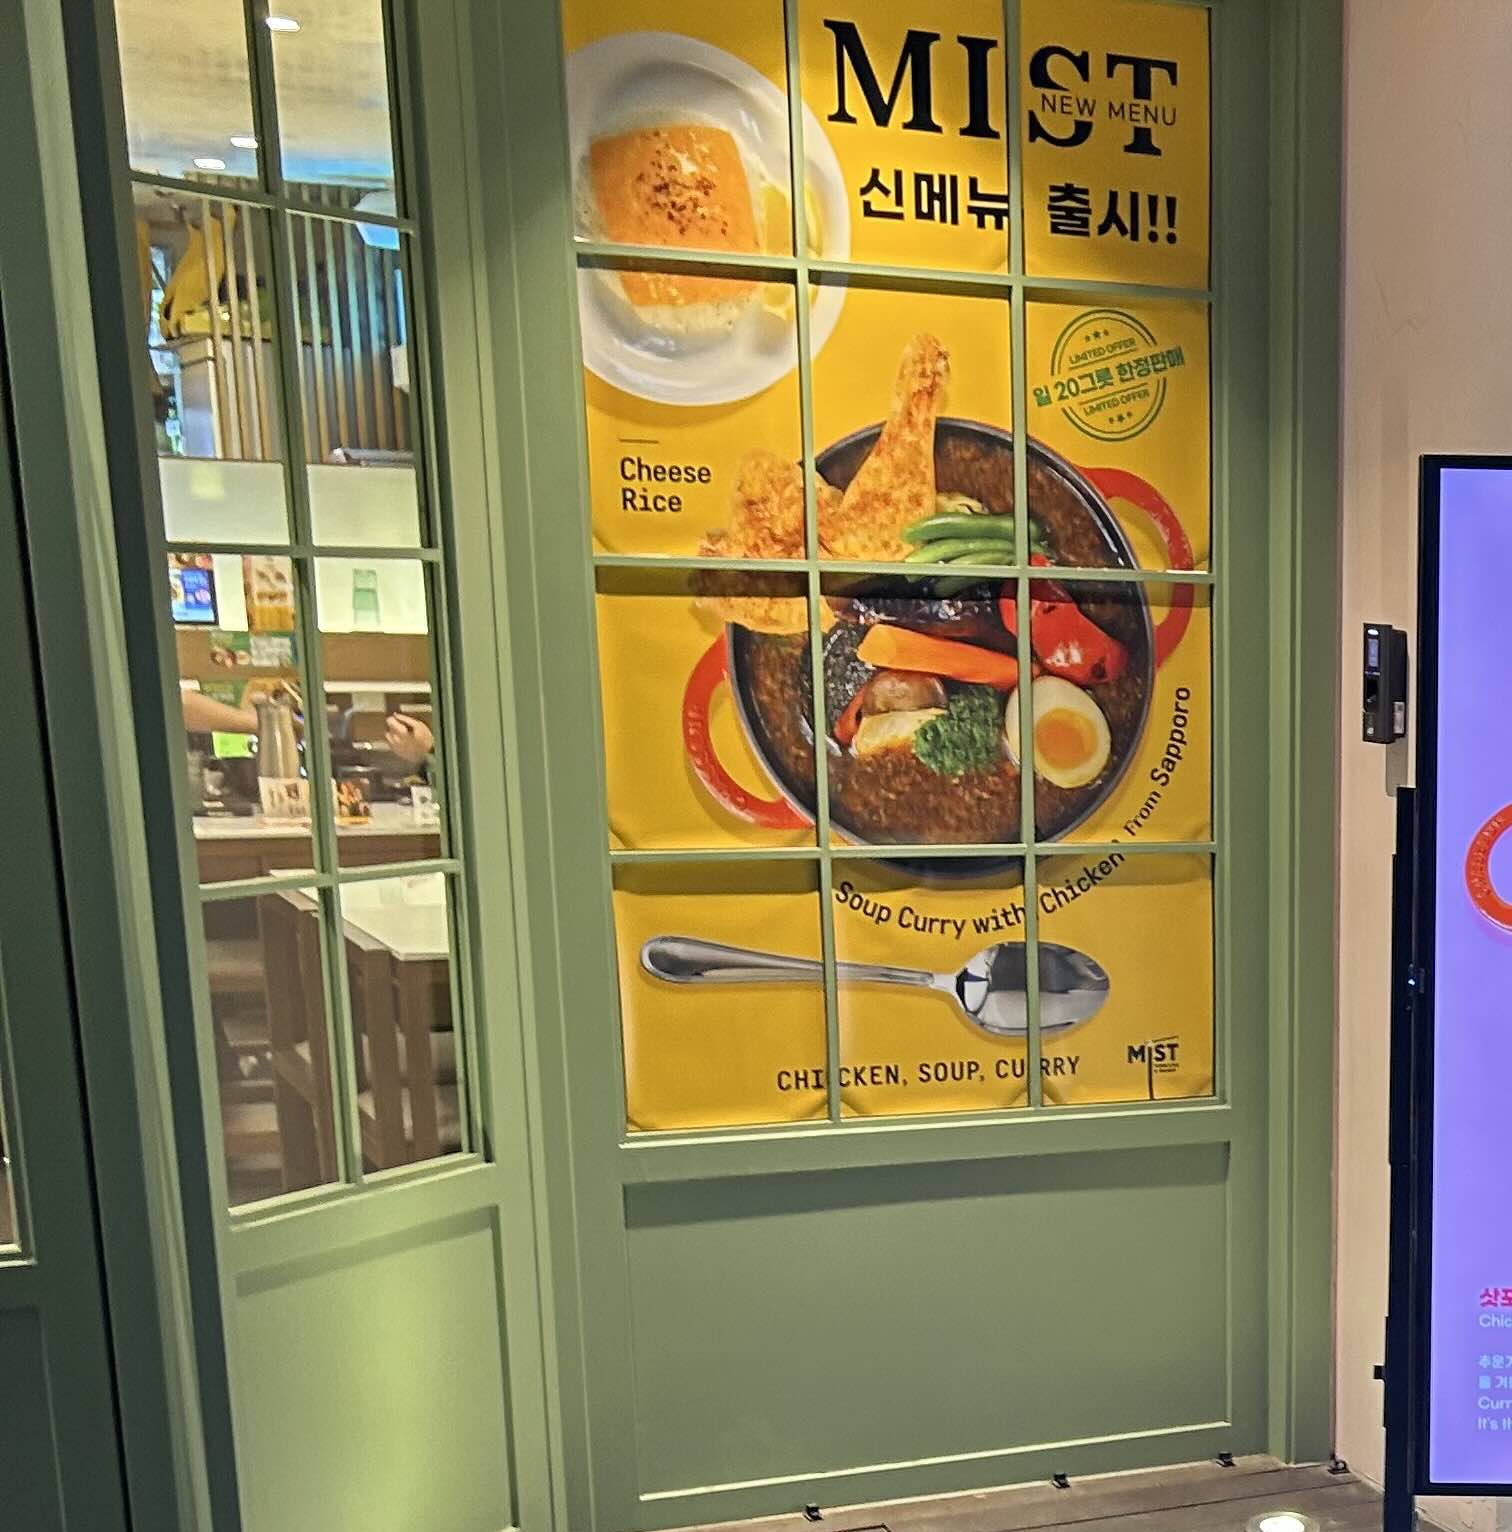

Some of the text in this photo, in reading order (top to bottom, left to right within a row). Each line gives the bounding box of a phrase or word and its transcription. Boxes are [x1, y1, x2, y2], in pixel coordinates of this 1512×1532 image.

[823, 19, 1178, 157] MIST
[1041, 93, 1177, 126] NEW MENU
[860, 167, 1177, 245] 신메뉴 출시!!
[1069, 337, 1136, 365] LIMITED OFFER
[1033, 345, 1185, 407] 일 20그릇 한정판매
[1083, 388, 1150, 416] LIMITED OFFER
[620, 456, 712, 484] Cheese
[622, 487, 683, 513] Rice
[835, 687, 1191, 940] Soup Curry with Chicken From Sapporo
[777, 1055, 1080, 1091] CHICKEN, SOUP, CURRY
[1478, 1416, 1498, 1431] It's
